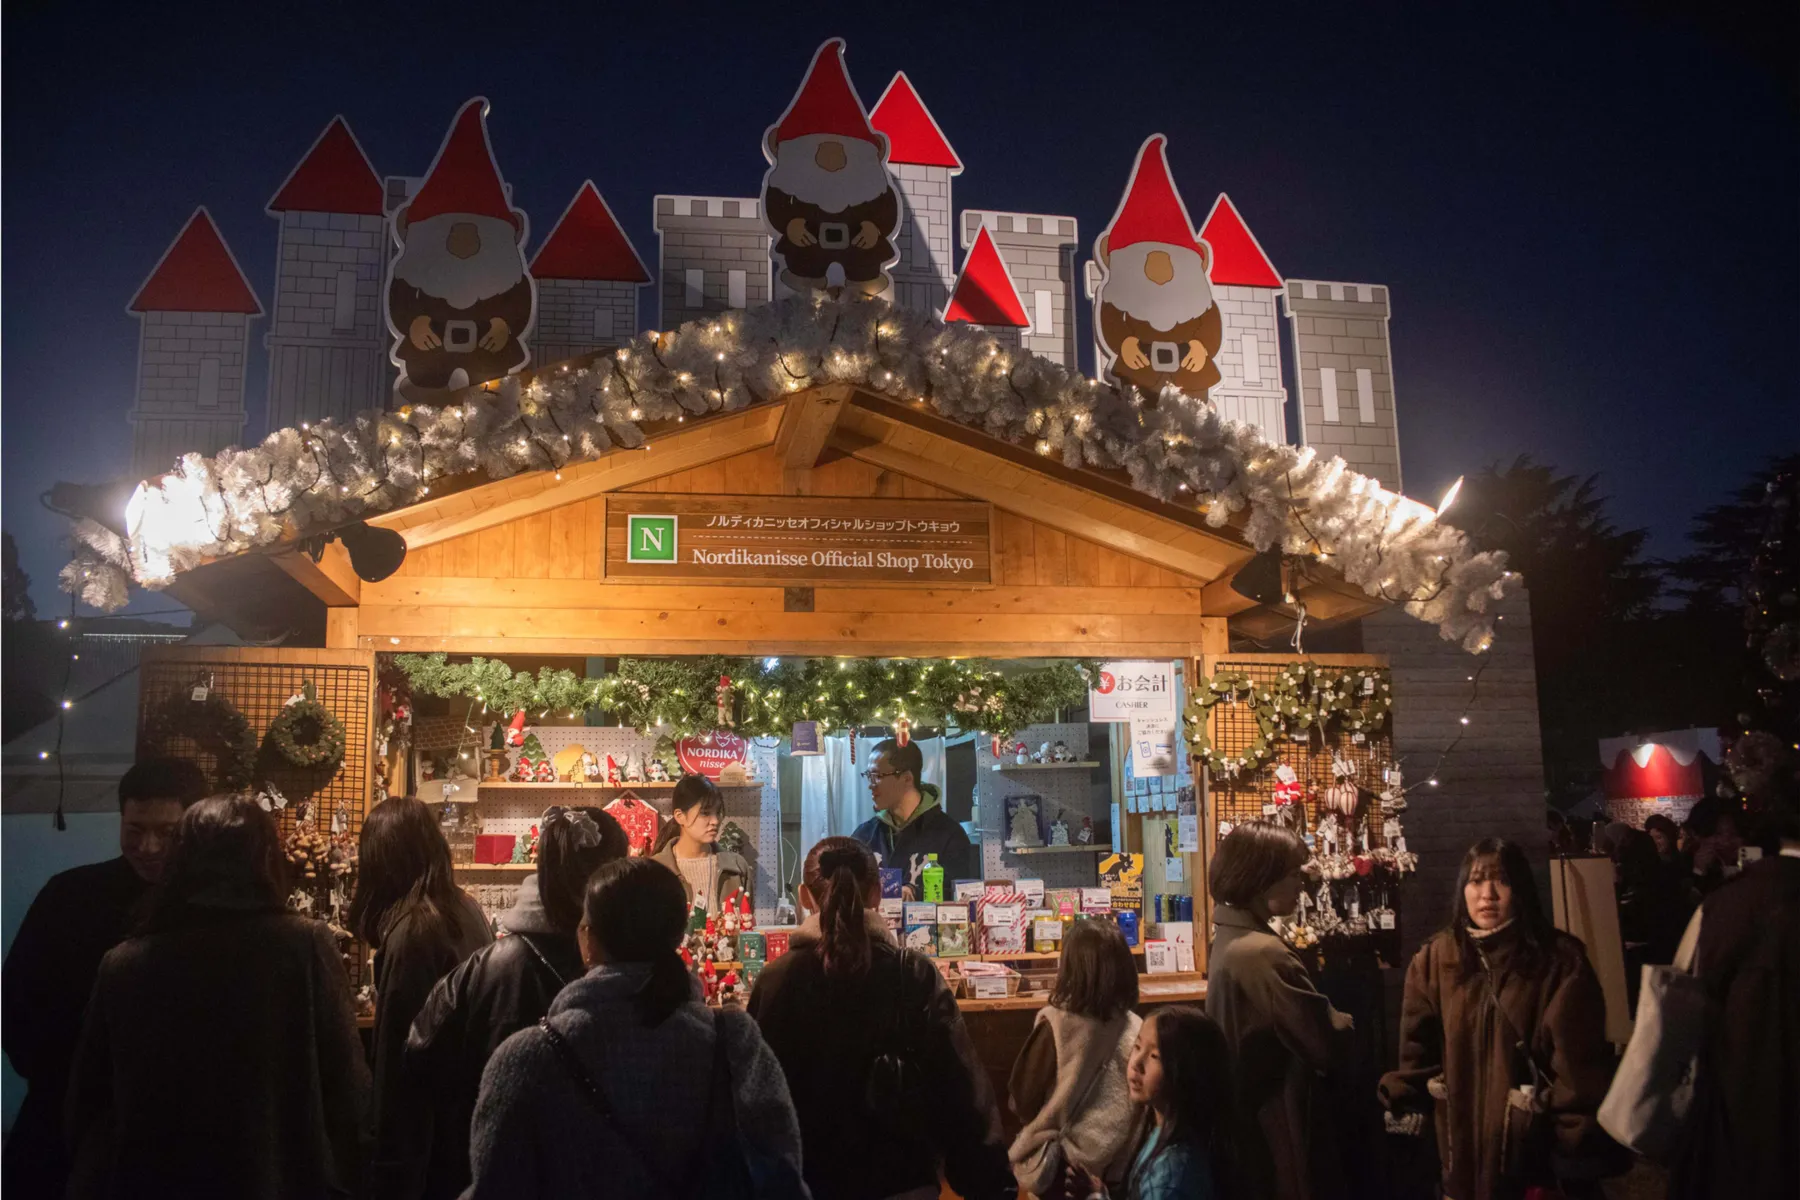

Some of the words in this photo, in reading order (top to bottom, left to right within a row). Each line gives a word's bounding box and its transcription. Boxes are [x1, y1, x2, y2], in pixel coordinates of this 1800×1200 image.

[640, 527, 665, 551] N
[692, 549, 808, 566] Nordikanisse
[811, 551, 873, 568] Official
[876, 552, 919, 573] Shop
[922, 553, 973, 573] Tokyo
[1117, 674, 1168, 692] お会計
[1115, 701, 1149, 709] CASHIER
[687, 747, 738, 760] NORDIKA
[699, 758, 726, 769] nisse
[644, 819, 652, 832] 3
